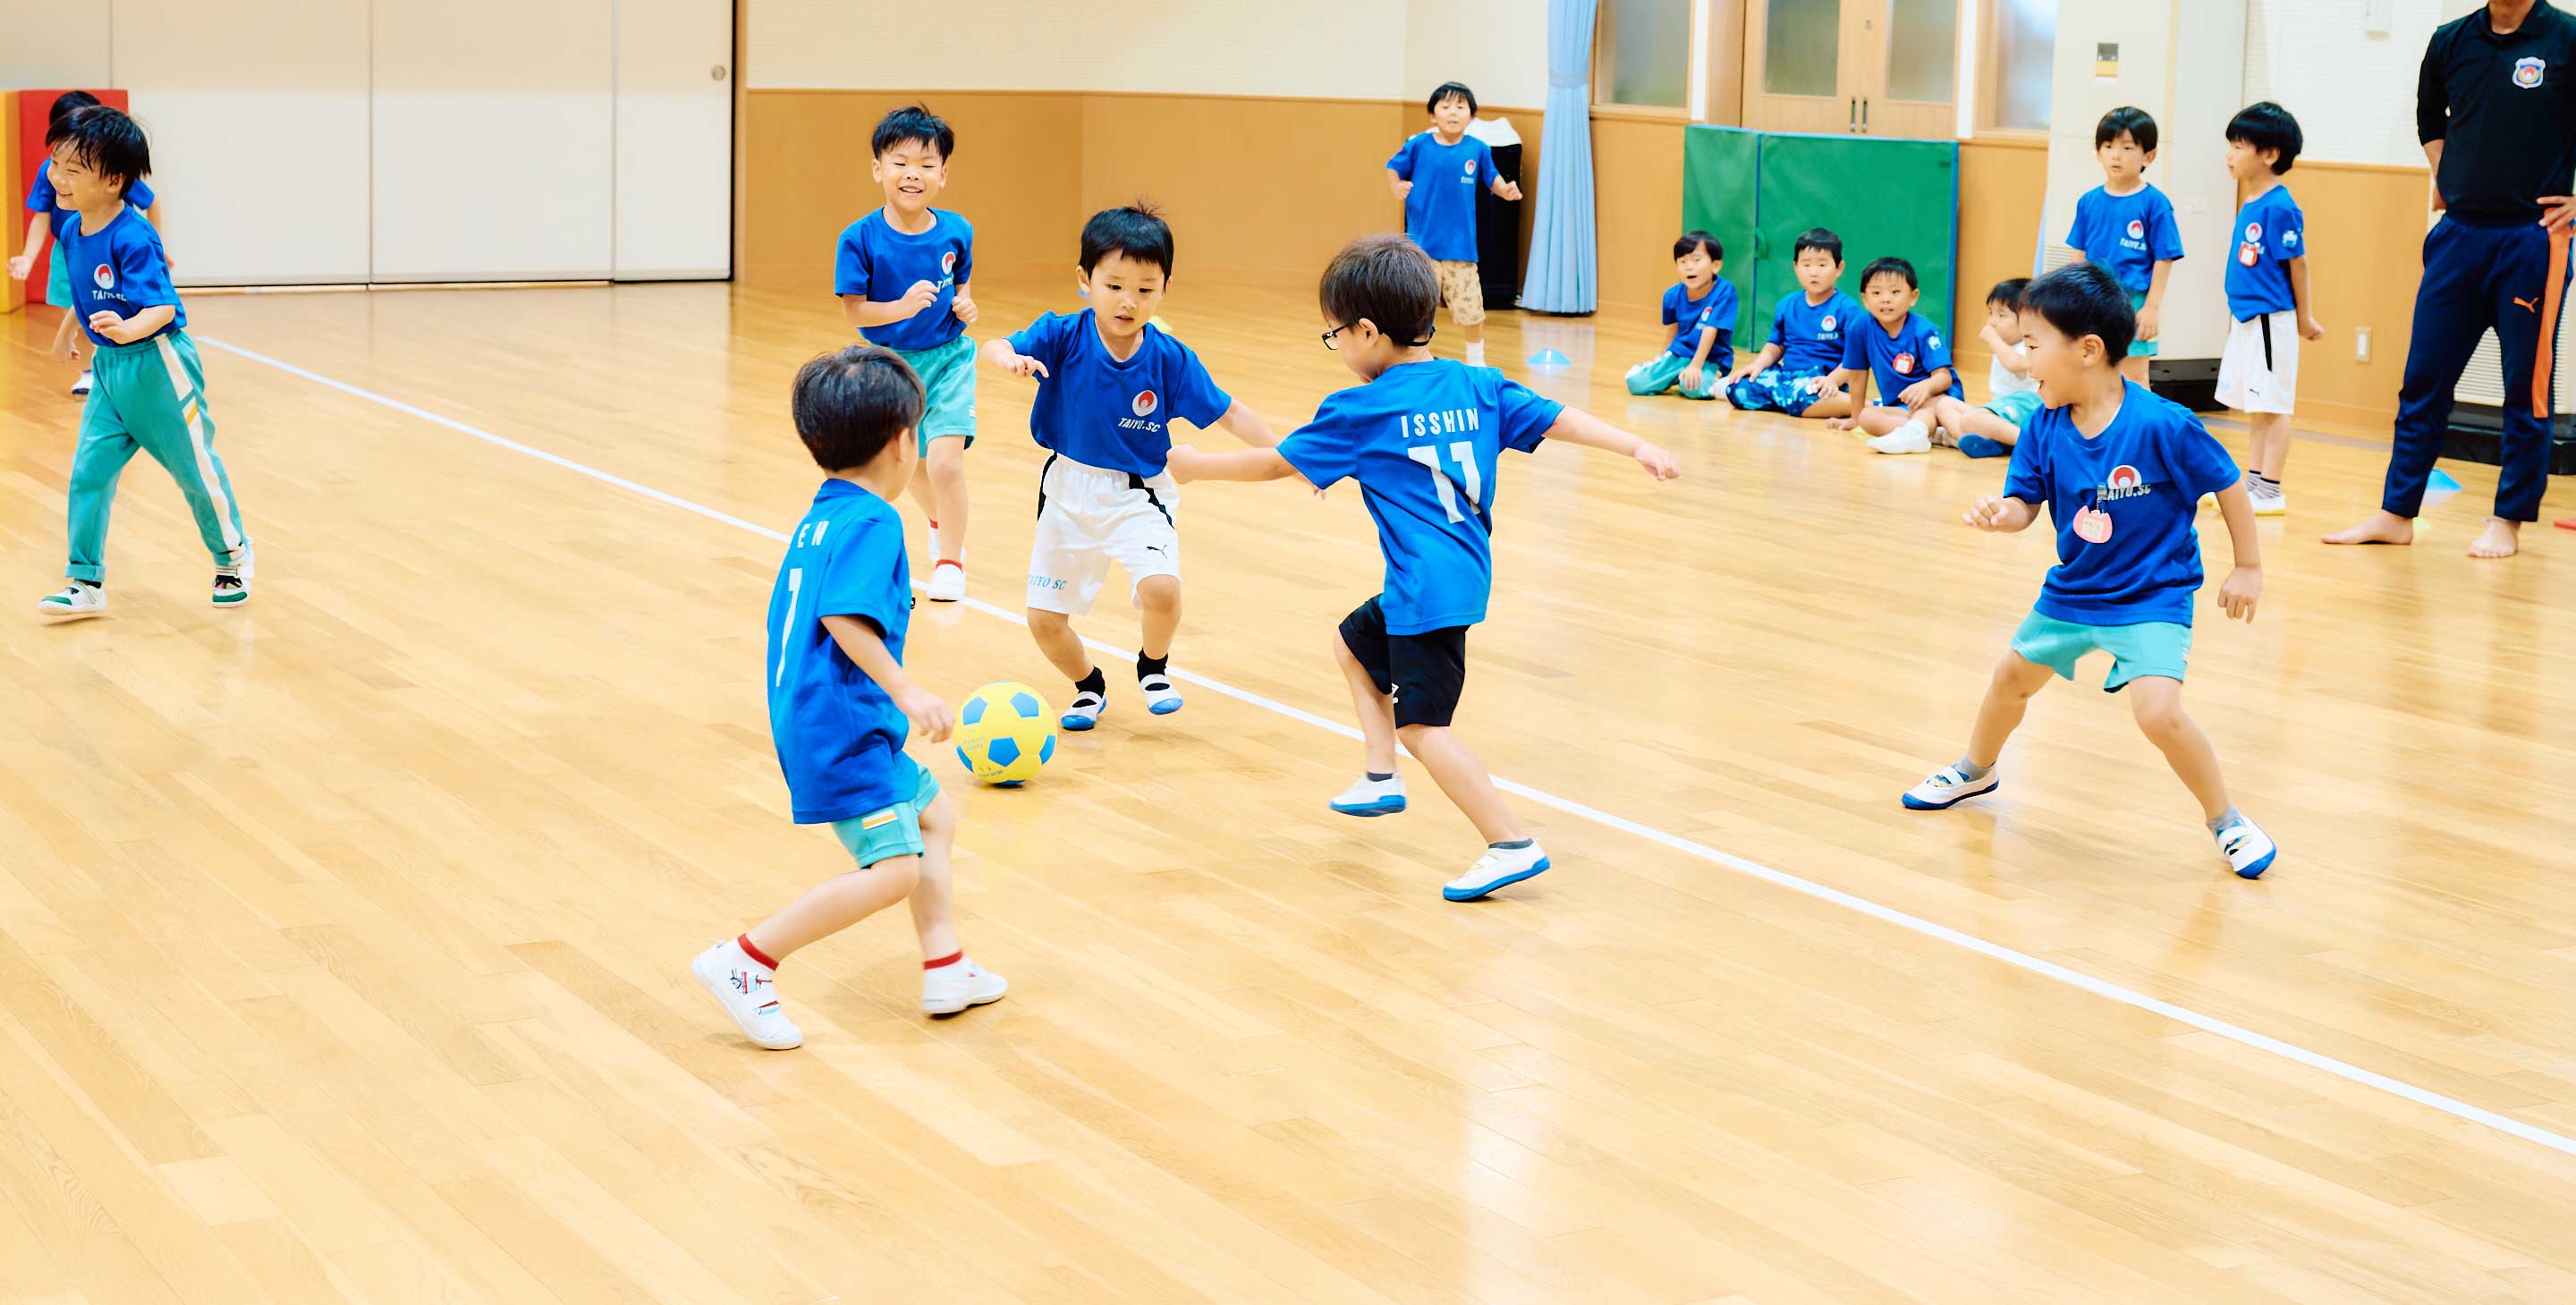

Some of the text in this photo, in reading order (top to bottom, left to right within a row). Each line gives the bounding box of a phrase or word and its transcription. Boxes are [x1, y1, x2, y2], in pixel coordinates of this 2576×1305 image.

[1118, 417, 1161, 433] TAIYO.SC
[1401, 408, 1479, 438] ISSHIN
[1407, 440, 1481, 524] 11
